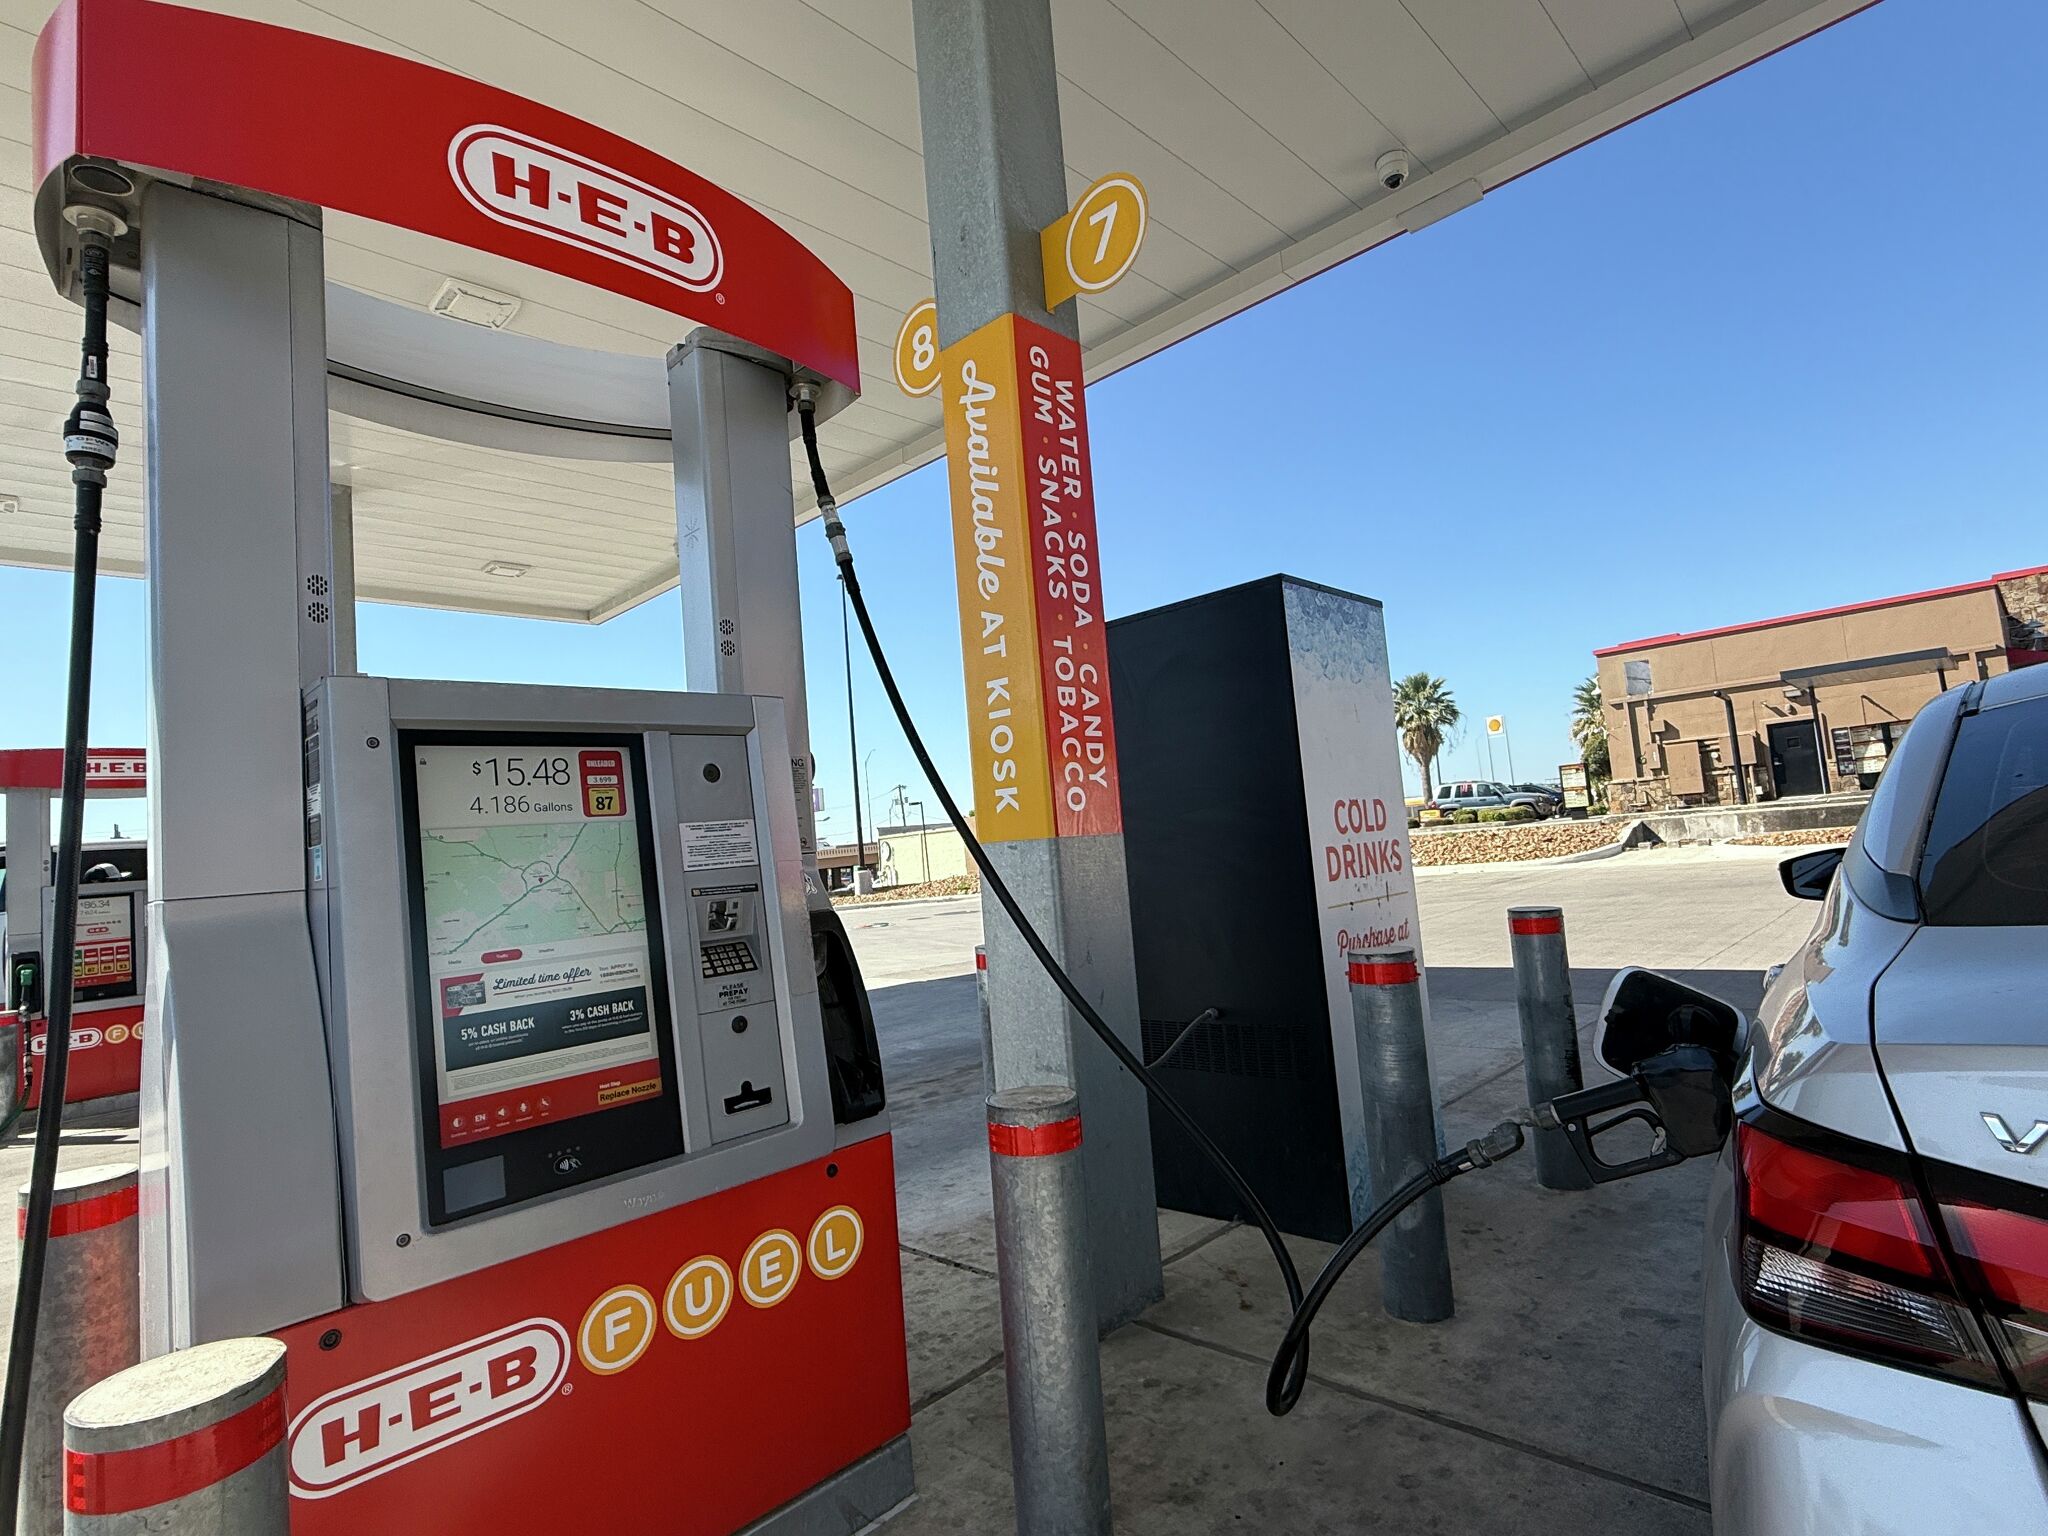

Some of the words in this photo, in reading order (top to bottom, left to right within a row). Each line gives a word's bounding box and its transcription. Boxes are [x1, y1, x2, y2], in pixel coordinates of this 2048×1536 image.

[492, 152, 695, 265] H-E-B
[1089, 201, 1118, 265] 7
[912, 325, 934, 372] 8
[1029, 345, 1053, 424] GUM
[1054, 381, 1082, 499] WATER
[959, 359, 1005, 601] Available
[1038, 454, 1068, 600] SNACKS
[1068, 530, 1093, 628] SODA
[981, 611, 1007, 658] AT
[986, 676, 1020, 814] KIOSK
[1053, 635, 1086, 812] TOBACCO
[1079, 663, 1107, 788] CANDY
[86, 762, 146, 773] H-E-B
[472, 757, 571, 787] $15.48
[470, 796, 530, 814] 4.186
[534, 802, 573, 813] Gallons
[596, 796, 613, 810] 87
[1334, 799, 1387, 834] COLD
[1326, 839, 1403, 882] DRINKS
[1337, 926, 1396, 958] Purchase
[1398, 918, 1410, 945] at
[493, 976, 537, 990] Limited
[538, 972, 560, 983] time
[563, 967, 592, 982] offer
[719, 988, 748, 999] PREPAY
[461, 1027, 478, 1041] 5%
[481, 1021, 506, 1037] CASH
[510, 1016, 535, 1032] BACK
[570, 1009, 584, 1021] 3%
[587, 1004, 610, 1018] CASH
[612, 1000, 634, 1013] BACK
[599, 1089, 630, 1102] Replace
[631, 1082, 656, 1094] Nozzle
[474, 1114, 486, 1122] EN
[321, 1346, 537, 1468] H-E-B
